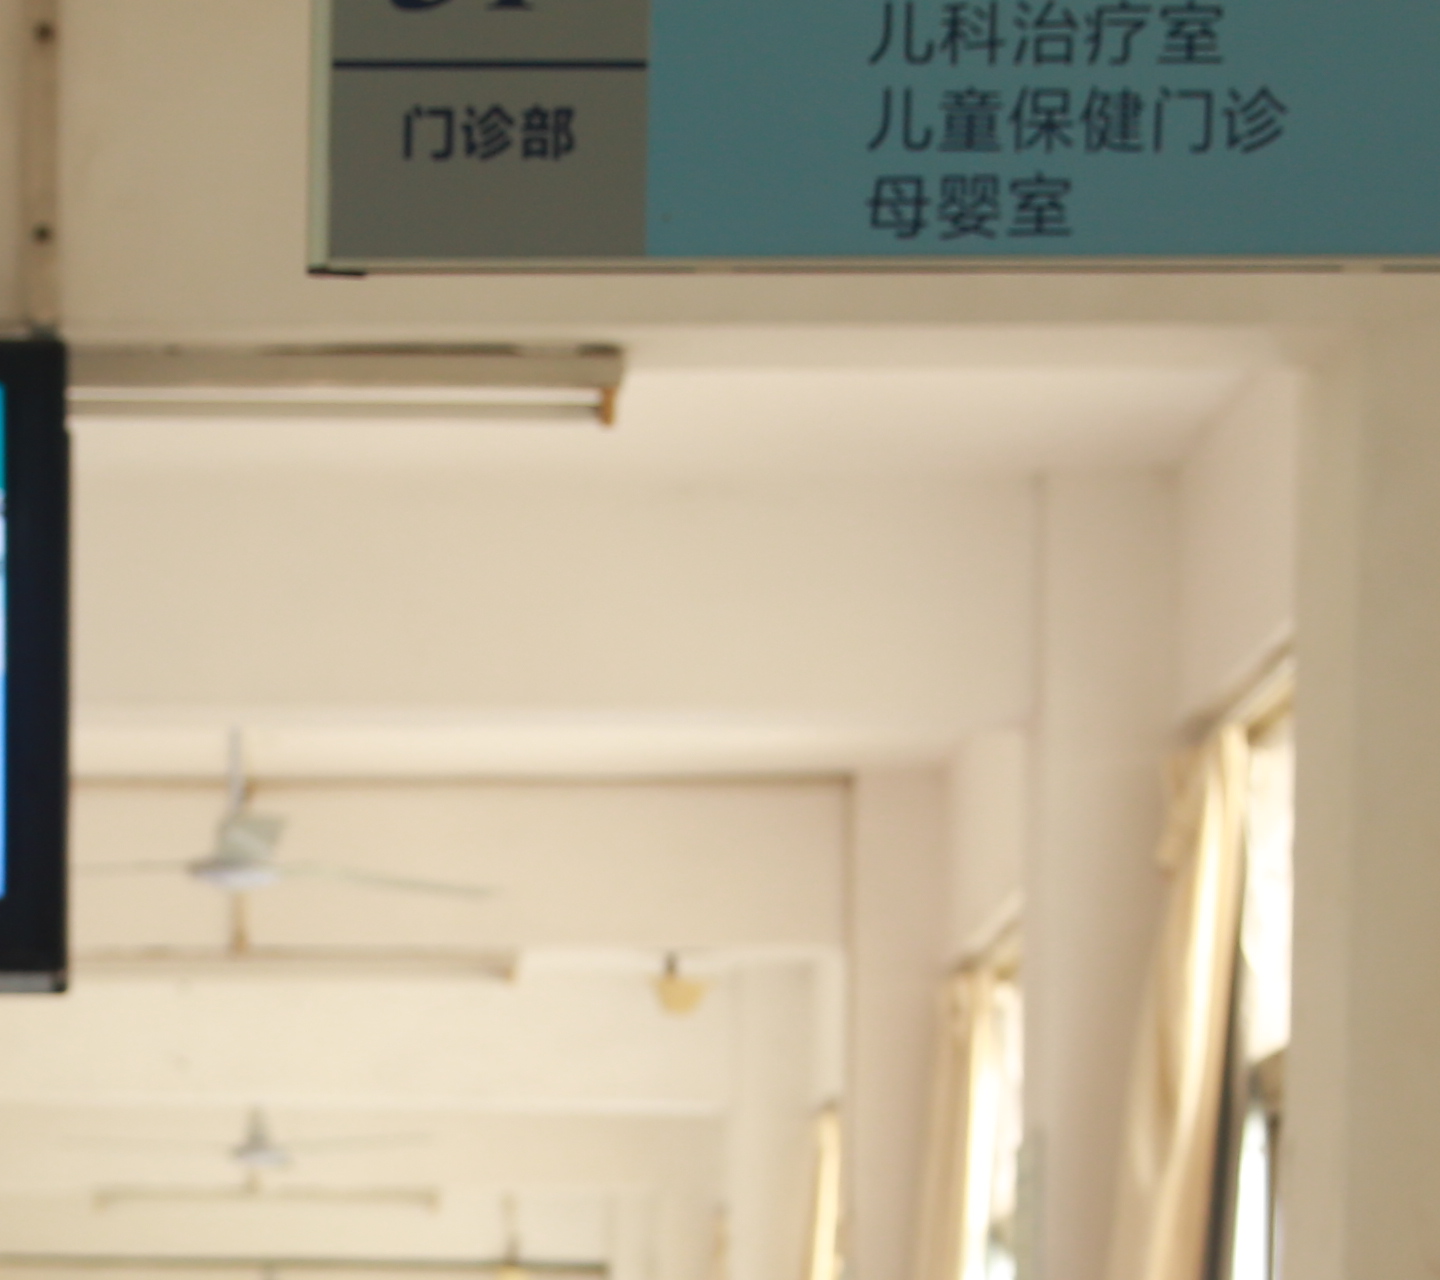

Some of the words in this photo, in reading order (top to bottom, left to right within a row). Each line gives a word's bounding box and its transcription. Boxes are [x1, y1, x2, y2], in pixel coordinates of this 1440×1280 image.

[867, 0, 1225, 65] 儿科治疗室
[402, 104, 577, 161] 门诊部
[867, 86, 1288, 154] 儿童保健门诊
[867, 171, 1073, 240] 母婴室
